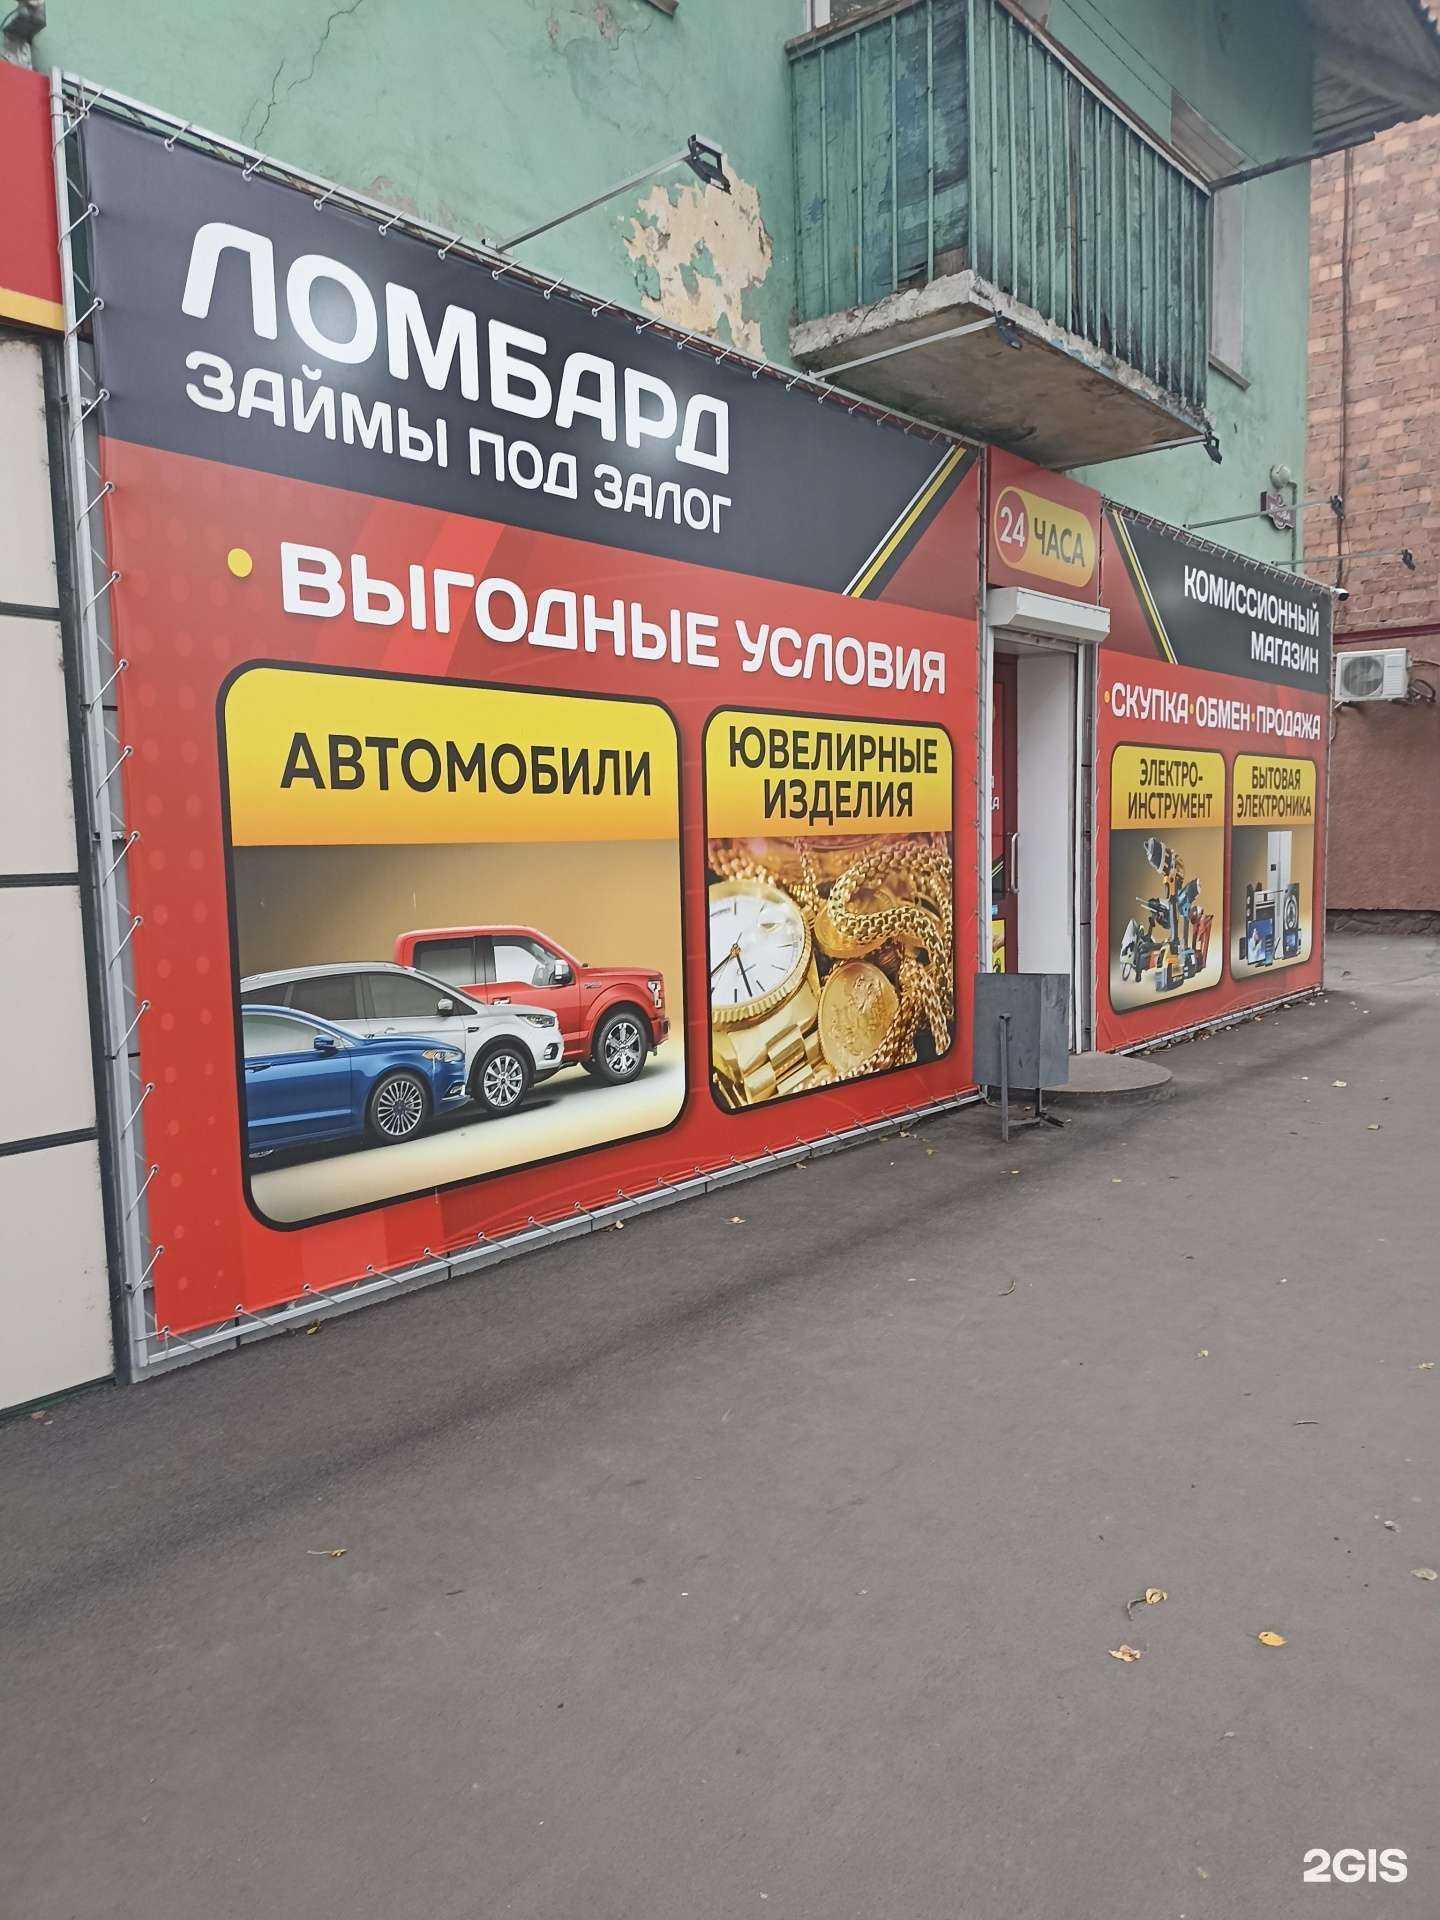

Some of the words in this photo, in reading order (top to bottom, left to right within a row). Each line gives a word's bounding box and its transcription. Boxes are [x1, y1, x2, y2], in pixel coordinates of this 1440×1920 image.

[181, 221, 731, 475] ЛОМБАРД
[185, 350, 448, 468] ЗАЙМЫ
[469, 427, 578, 500] ПОД
[593, 464, 732, 535] ЗАЛОГ
[1000, 506, 1025, 548] 24
[1034, 517, 1085, 568] ЧАСА
[280, 541, 720, 669] ВЫГОДНЫЕ
[735, 618, 946, 695] УСЛОВИЯ
[1184, 564, 1319, 637] КОМИССИОННЫЙ
[1251, 630, 1319, 675] МАГАЗИН
[1111, 681, 1189, 725] СКУПКА
[1195, 695, 1251, 732] ОБМЕН
[1256, 704, 1321, 741] ПРОДАЖА
[281, 732, 651, 797] АВТОМОБИЛИ
[729, 725, 938, 775] ЮВЕЛИРНЫЕ
[1139, 757, 1204, 788] ЭЛЕКТРО-
[763, 777, 914, 828] ИЗДЕЛИЯ
[1127, 791, 1213, 820] ИНСТРУМЕНТ
[1251, 765, 1301, 791] БЫТОВАЯ
[1236, 793, 1312, 819] ЭЛЕКТРОНИКА
